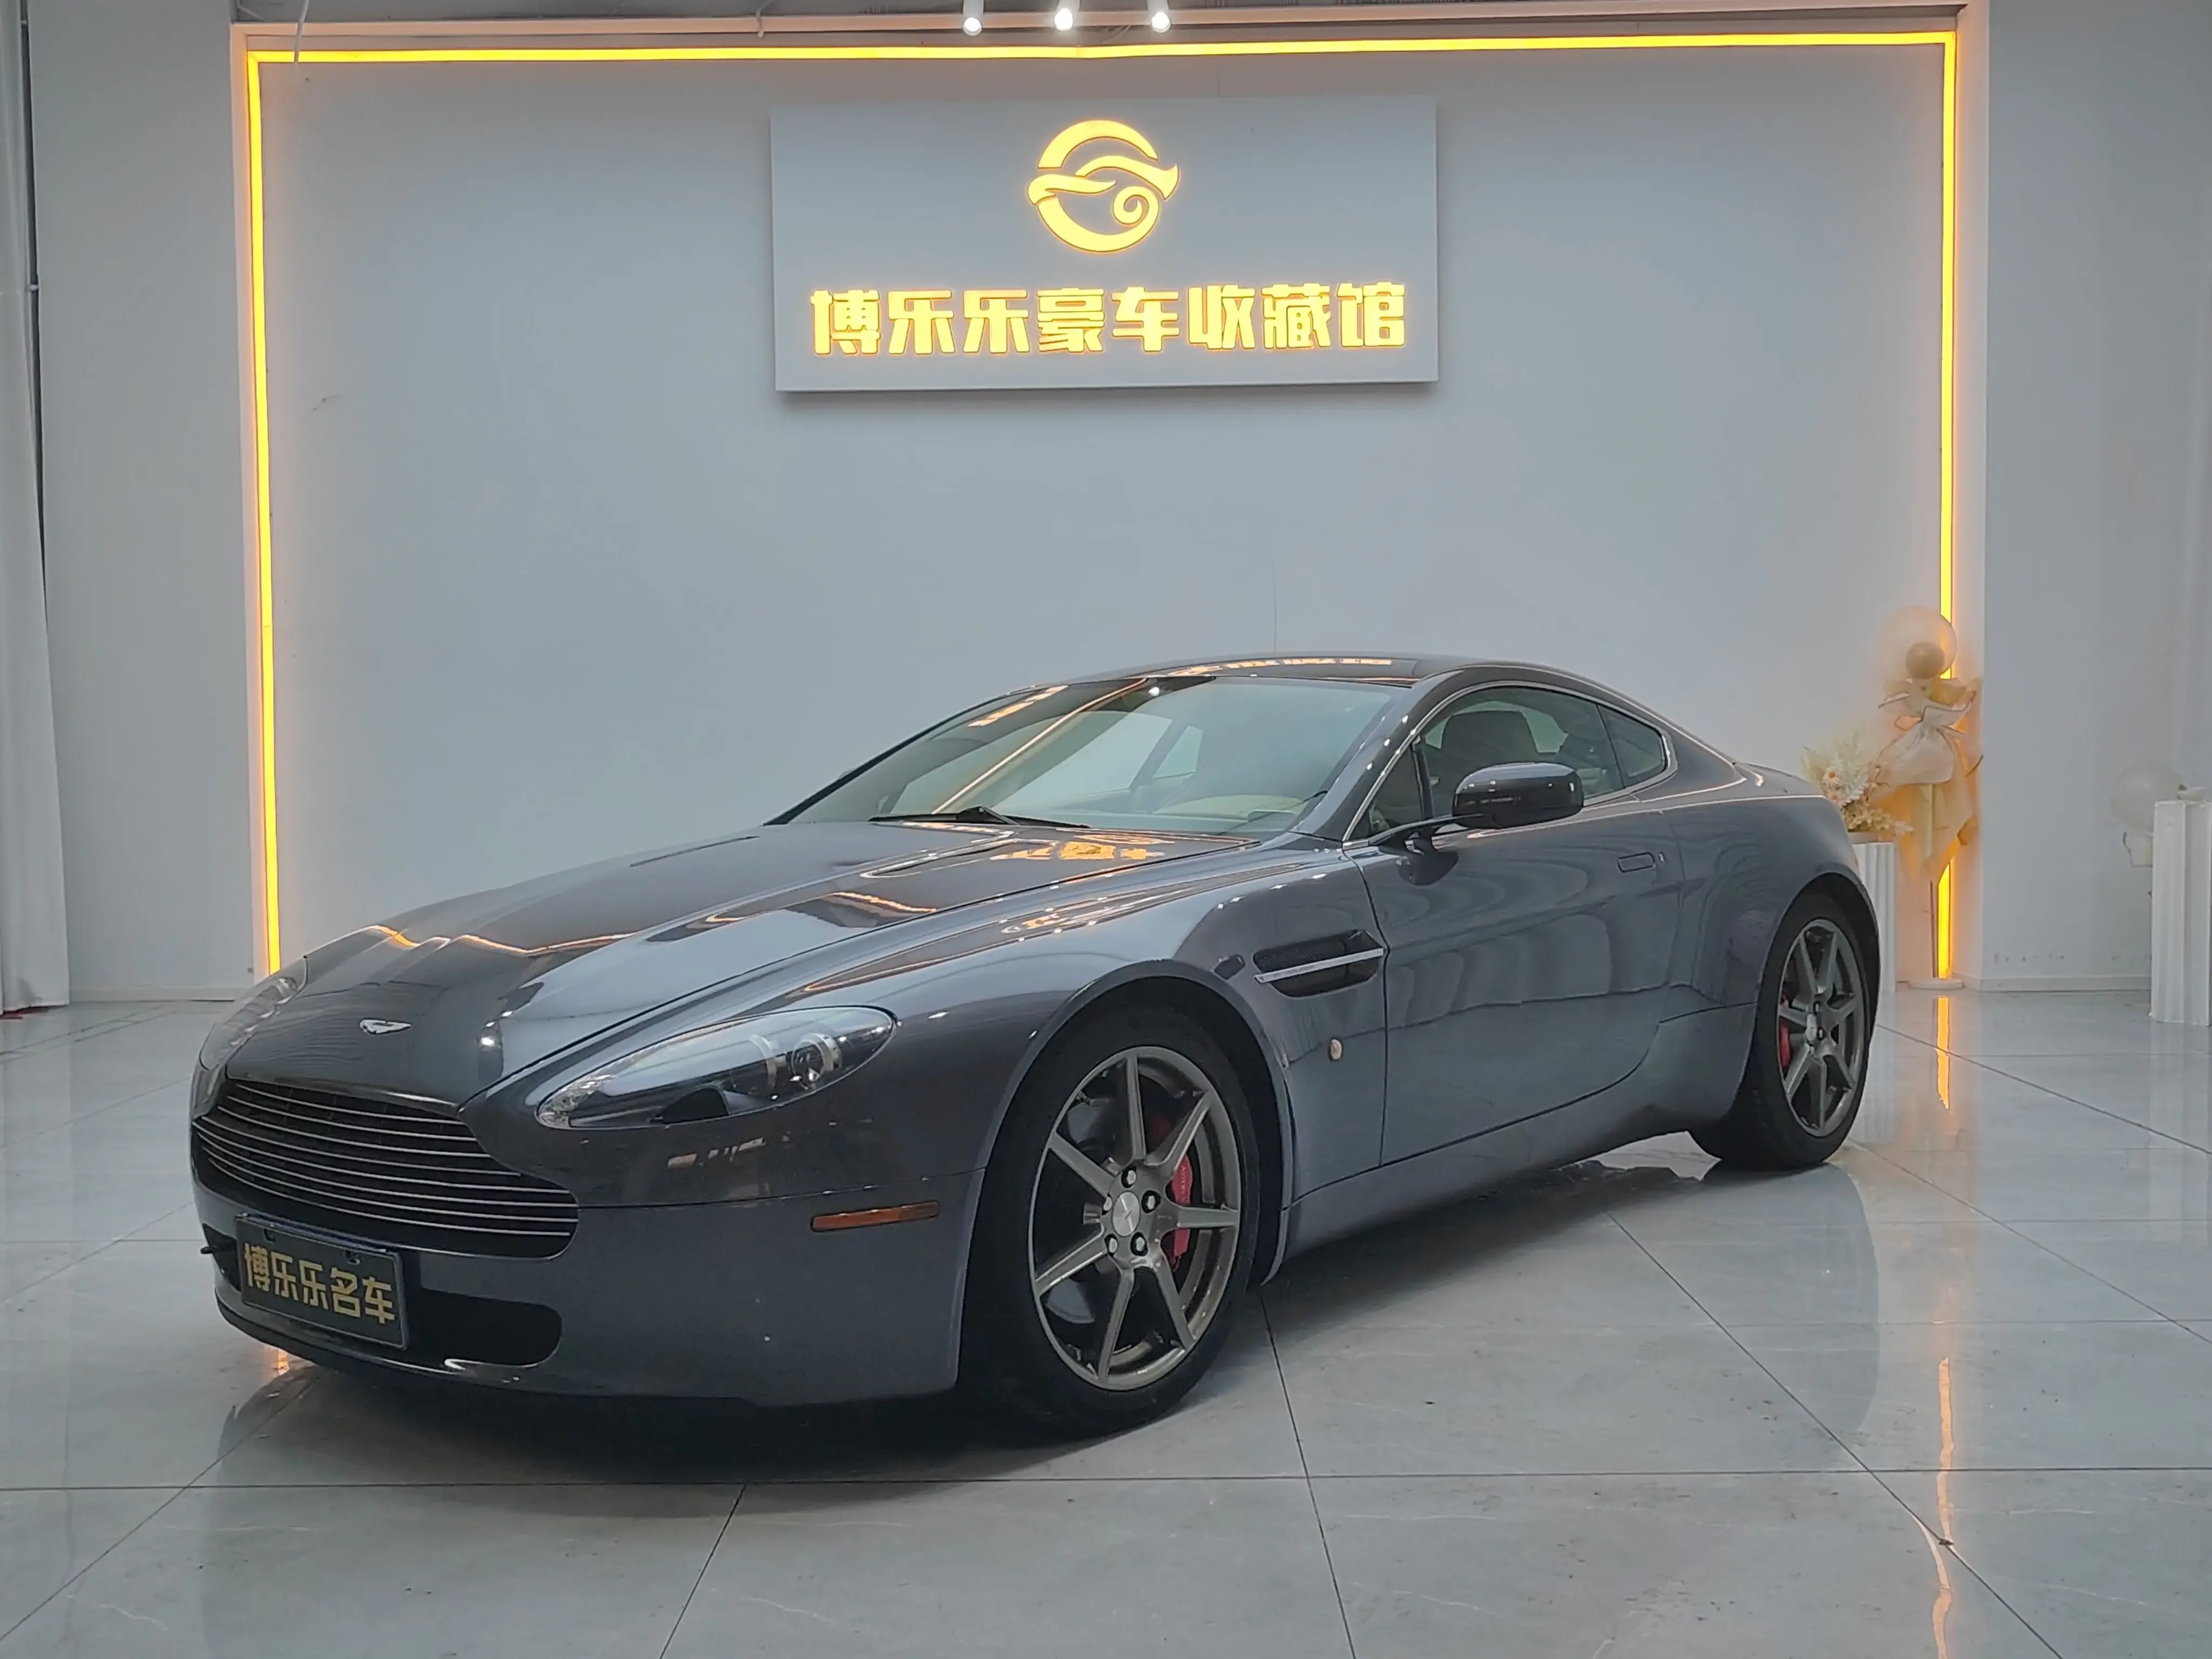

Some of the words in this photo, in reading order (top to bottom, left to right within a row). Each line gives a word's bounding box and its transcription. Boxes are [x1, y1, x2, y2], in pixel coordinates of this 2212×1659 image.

[810, 281, 1406, 356] 博乐乐豪车收藏馆
[244, 1243, 395, 1324] 博乐乐名车
